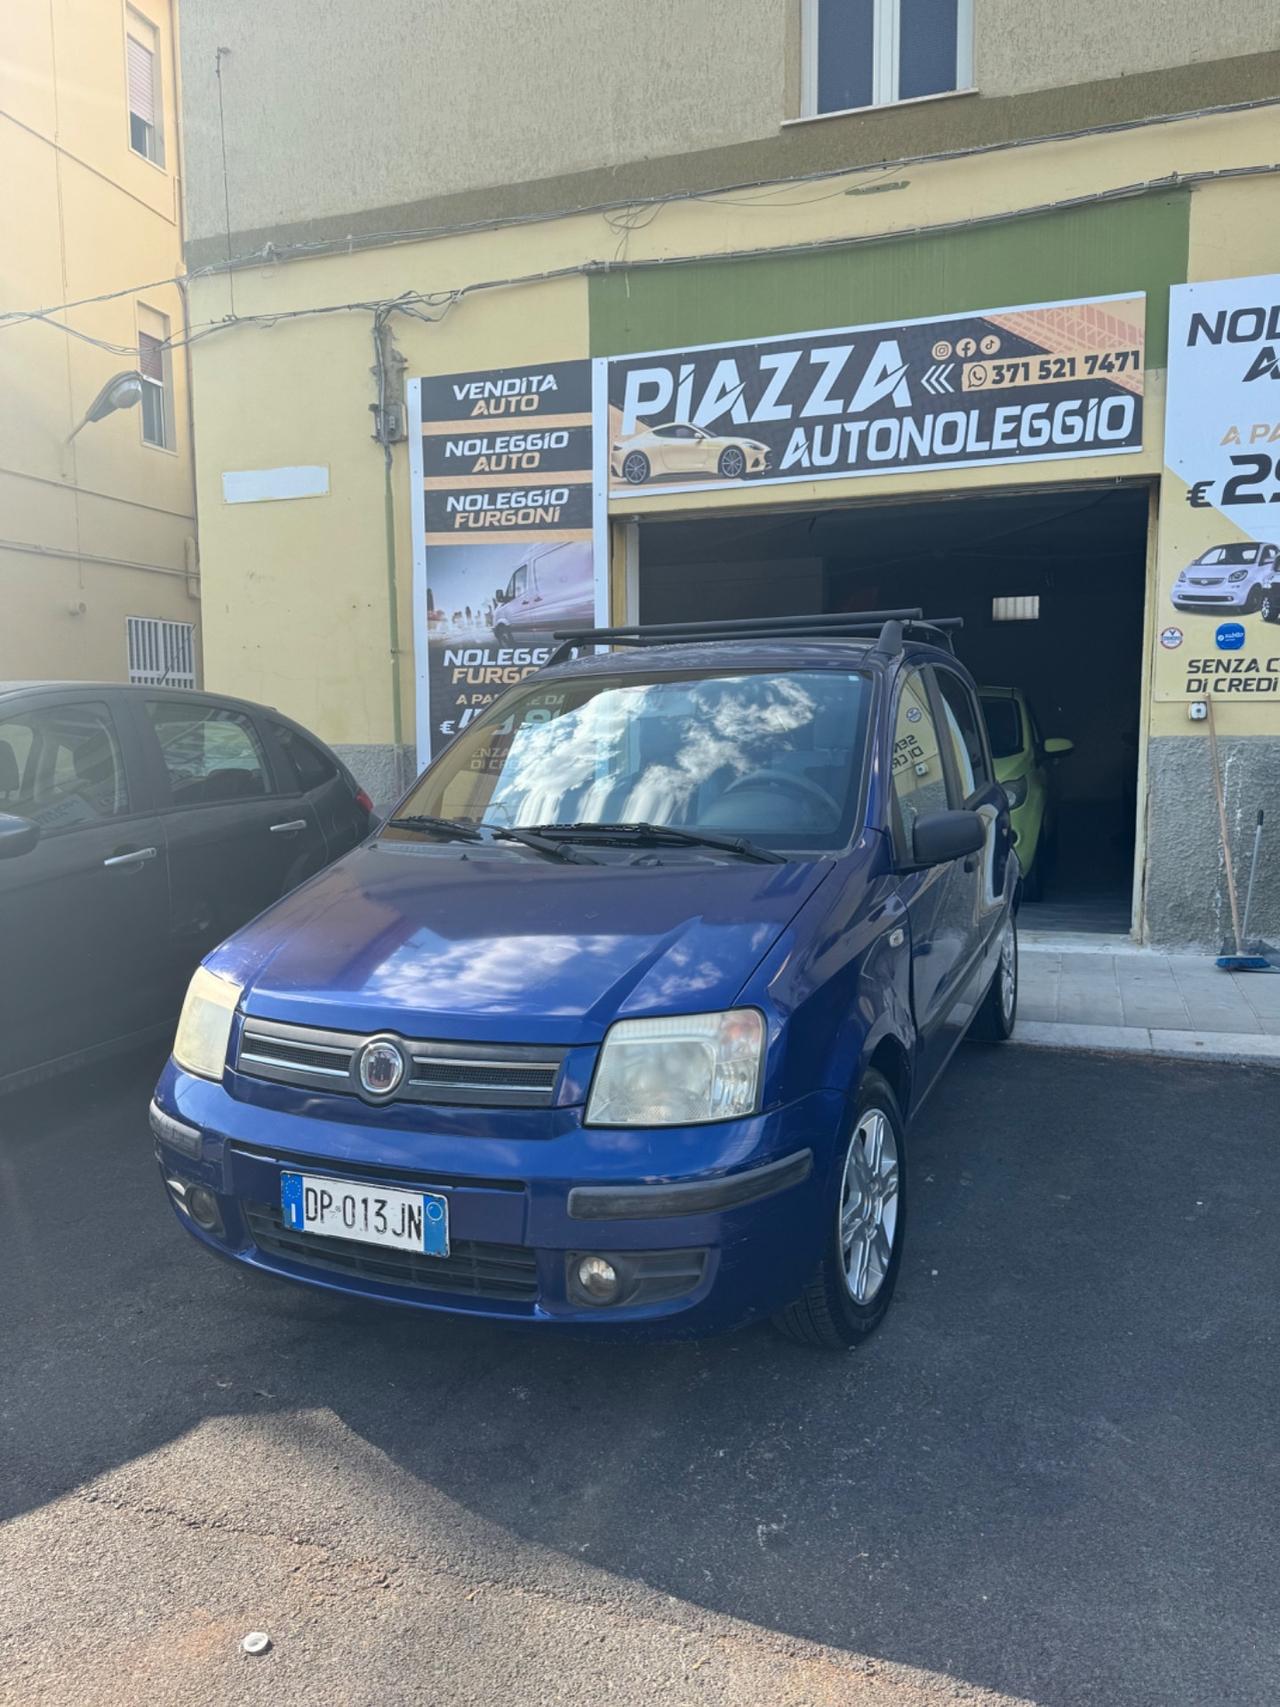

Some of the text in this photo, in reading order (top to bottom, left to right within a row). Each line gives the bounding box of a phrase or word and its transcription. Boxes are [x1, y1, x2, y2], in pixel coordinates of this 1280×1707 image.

[991, 350, 1140, 385] 371 521 7471
[621, 340, 913, 436] PIAZZA
[470, 394, 540, 416] AUTO
[779, 395, 1135, 470] AUTONOLEGGIO
[1220, 425, 1241, 446] A
[472, 452, 540, 473] AUTO
[1221, 453, 1280, 505] 2
[443, 647, 579, 666] NOLEGG
[1186, 658, 1260, 674] SENZA
[456, 694, 467, 705] A
[305, 1187, 423, 1241] DP 013JN
